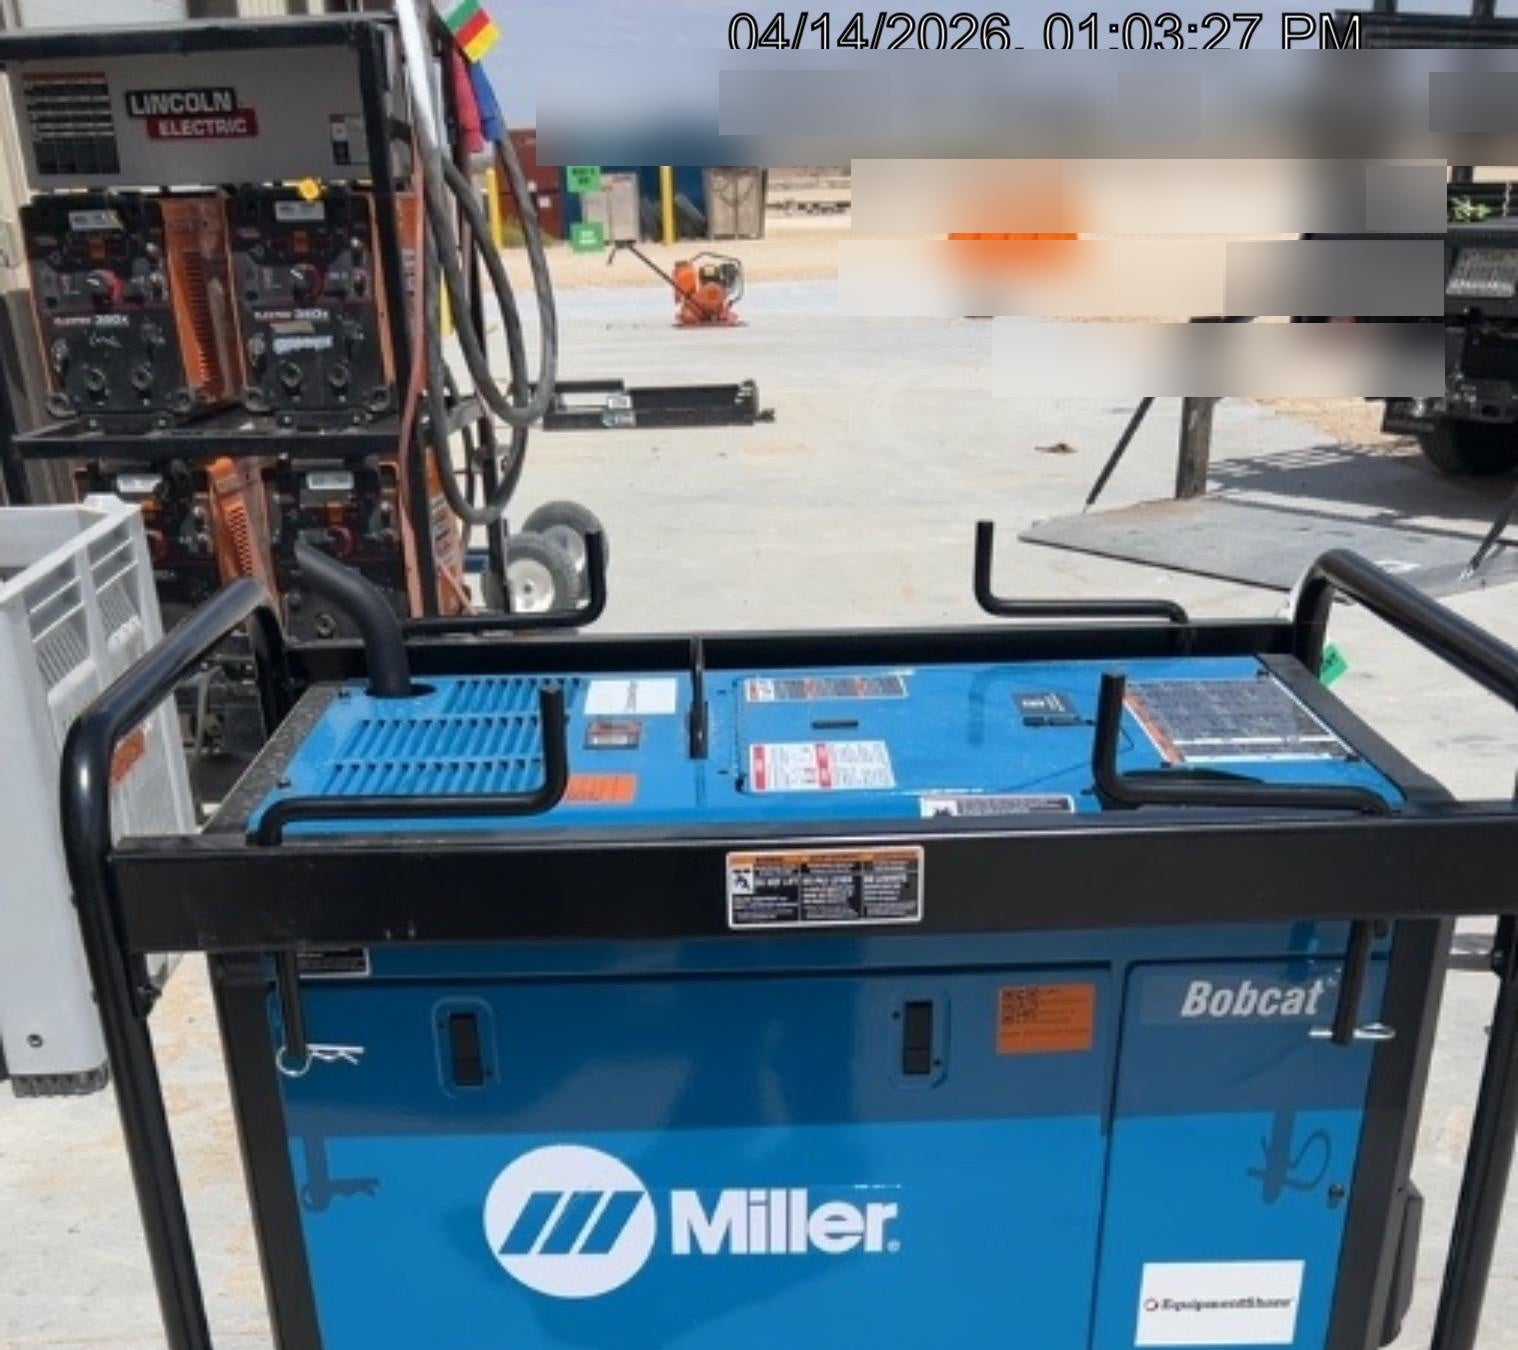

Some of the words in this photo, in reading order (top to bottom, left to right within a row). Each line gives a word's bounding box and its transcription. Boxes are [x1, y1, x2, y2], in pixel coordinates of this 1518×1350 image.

[130, 91, 232, 115] LINCOLN
[159, 119, 247, 136] ELECTRIC
[1181, 980, 1325, 1017] Bobcat
[671, 1187, 899, 1255] Miller
[1161, 1296, 1291, 1312] EquipmentShare
